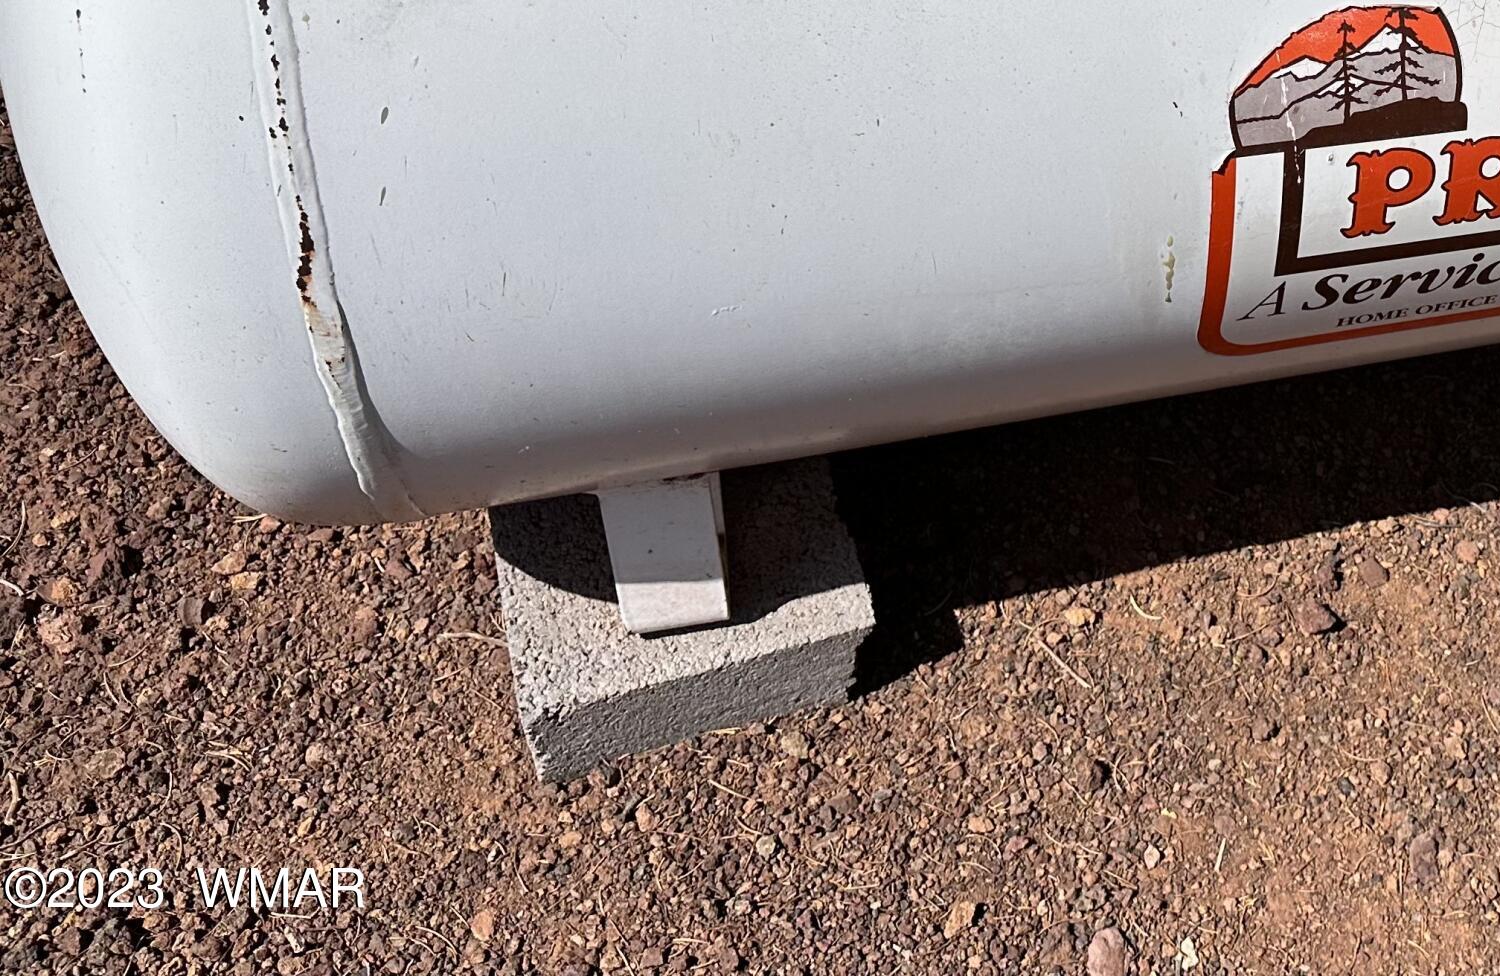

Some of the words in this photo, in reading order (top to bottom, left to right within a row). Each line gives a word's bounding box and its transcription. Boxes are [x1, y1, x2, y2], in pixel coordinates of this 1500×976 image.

[1235, 280, 1288, 322] A
[1335, 308, 1408, 328] HOME
[1415, 294, 1498, 316] OFFICE
